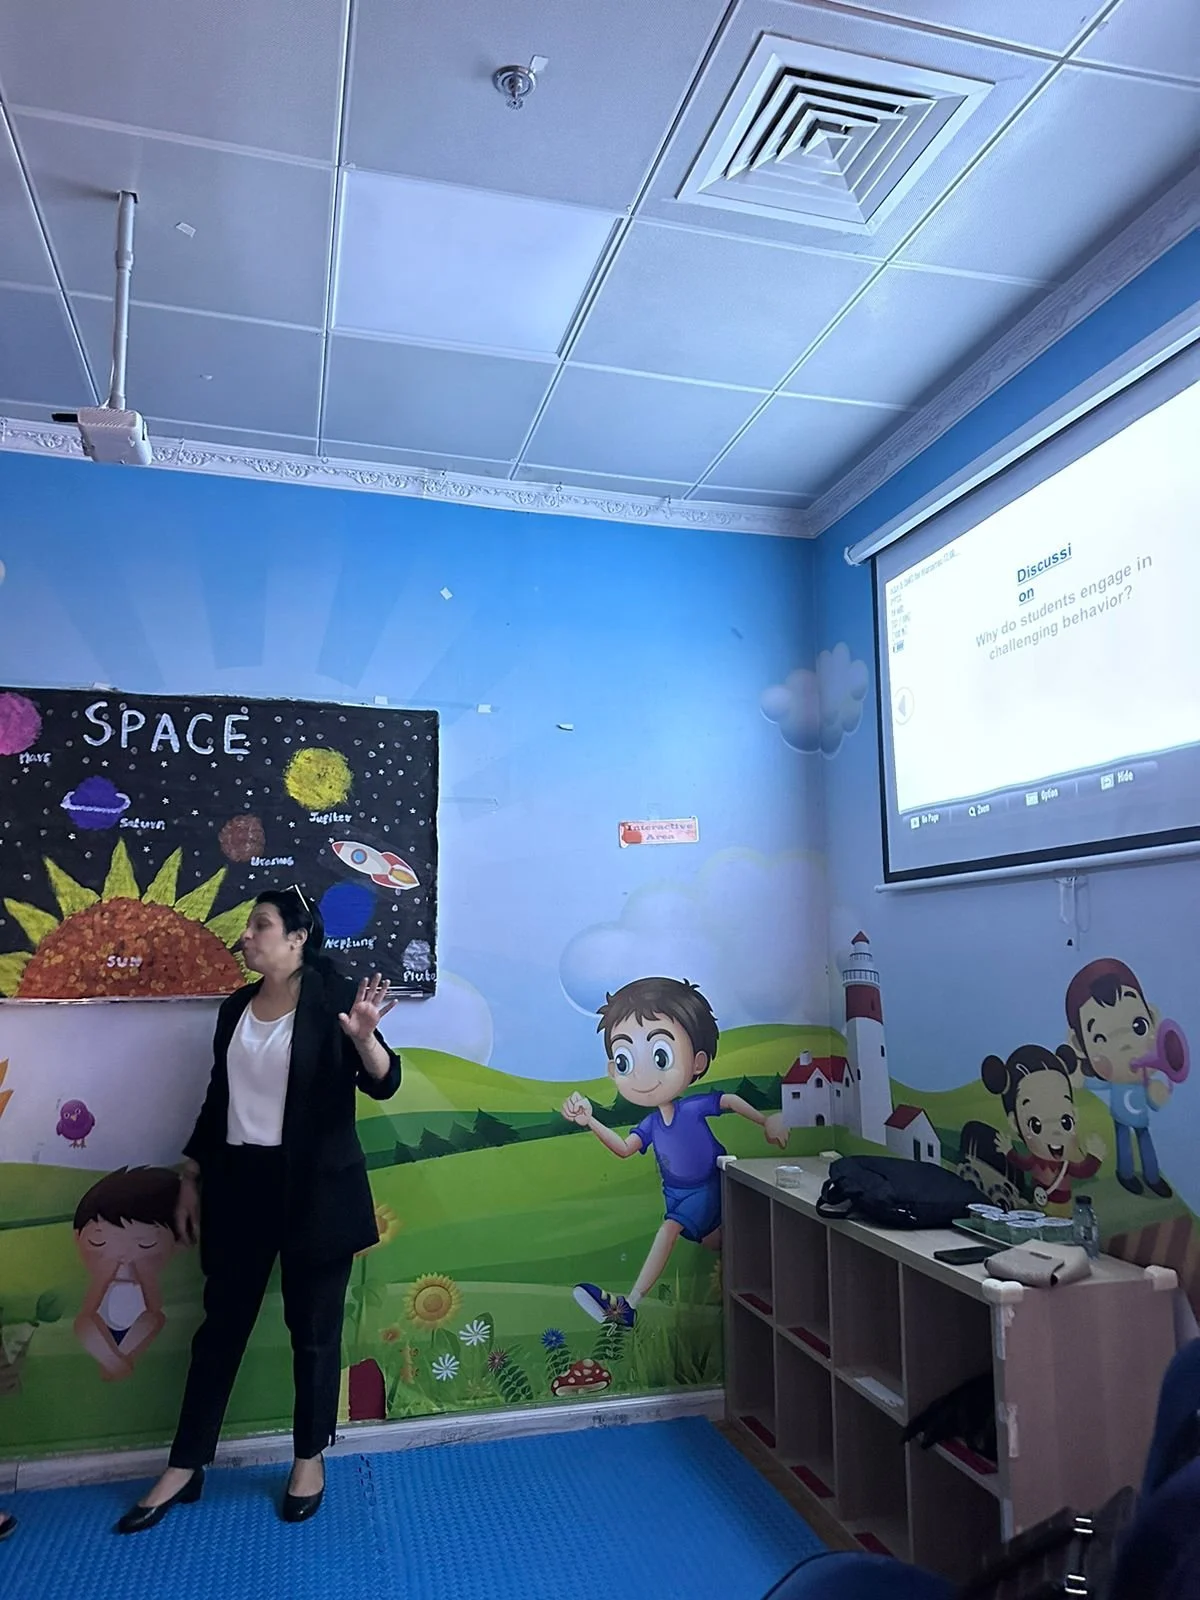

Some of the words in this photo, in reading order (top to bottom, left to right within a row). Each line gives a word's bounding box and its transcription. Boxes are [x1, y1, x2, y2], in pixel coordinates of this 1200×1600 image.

[1017, 543, 1072, 582] Discussi
[976, 627, 998, 648] Why
[1001, 617, 1016, 633] do
[1020, 590, 1076, 626] students
[1080, 565, 1131, 600] engage
[1136, 554, 1152, 572] in
[1018, 587, 1034, 603] on
[989, 620, 1058, 660] challenging
[1062, 585, 1133, 628] behavior?
[83, 701, 250, 755] SPACE
[1117, 770, 1133, 783] Hide
[119, 818, 165, 830] Saturn
[627, 823, 693, 831] Interactive
[403, 969, 438, 982] Pluto
